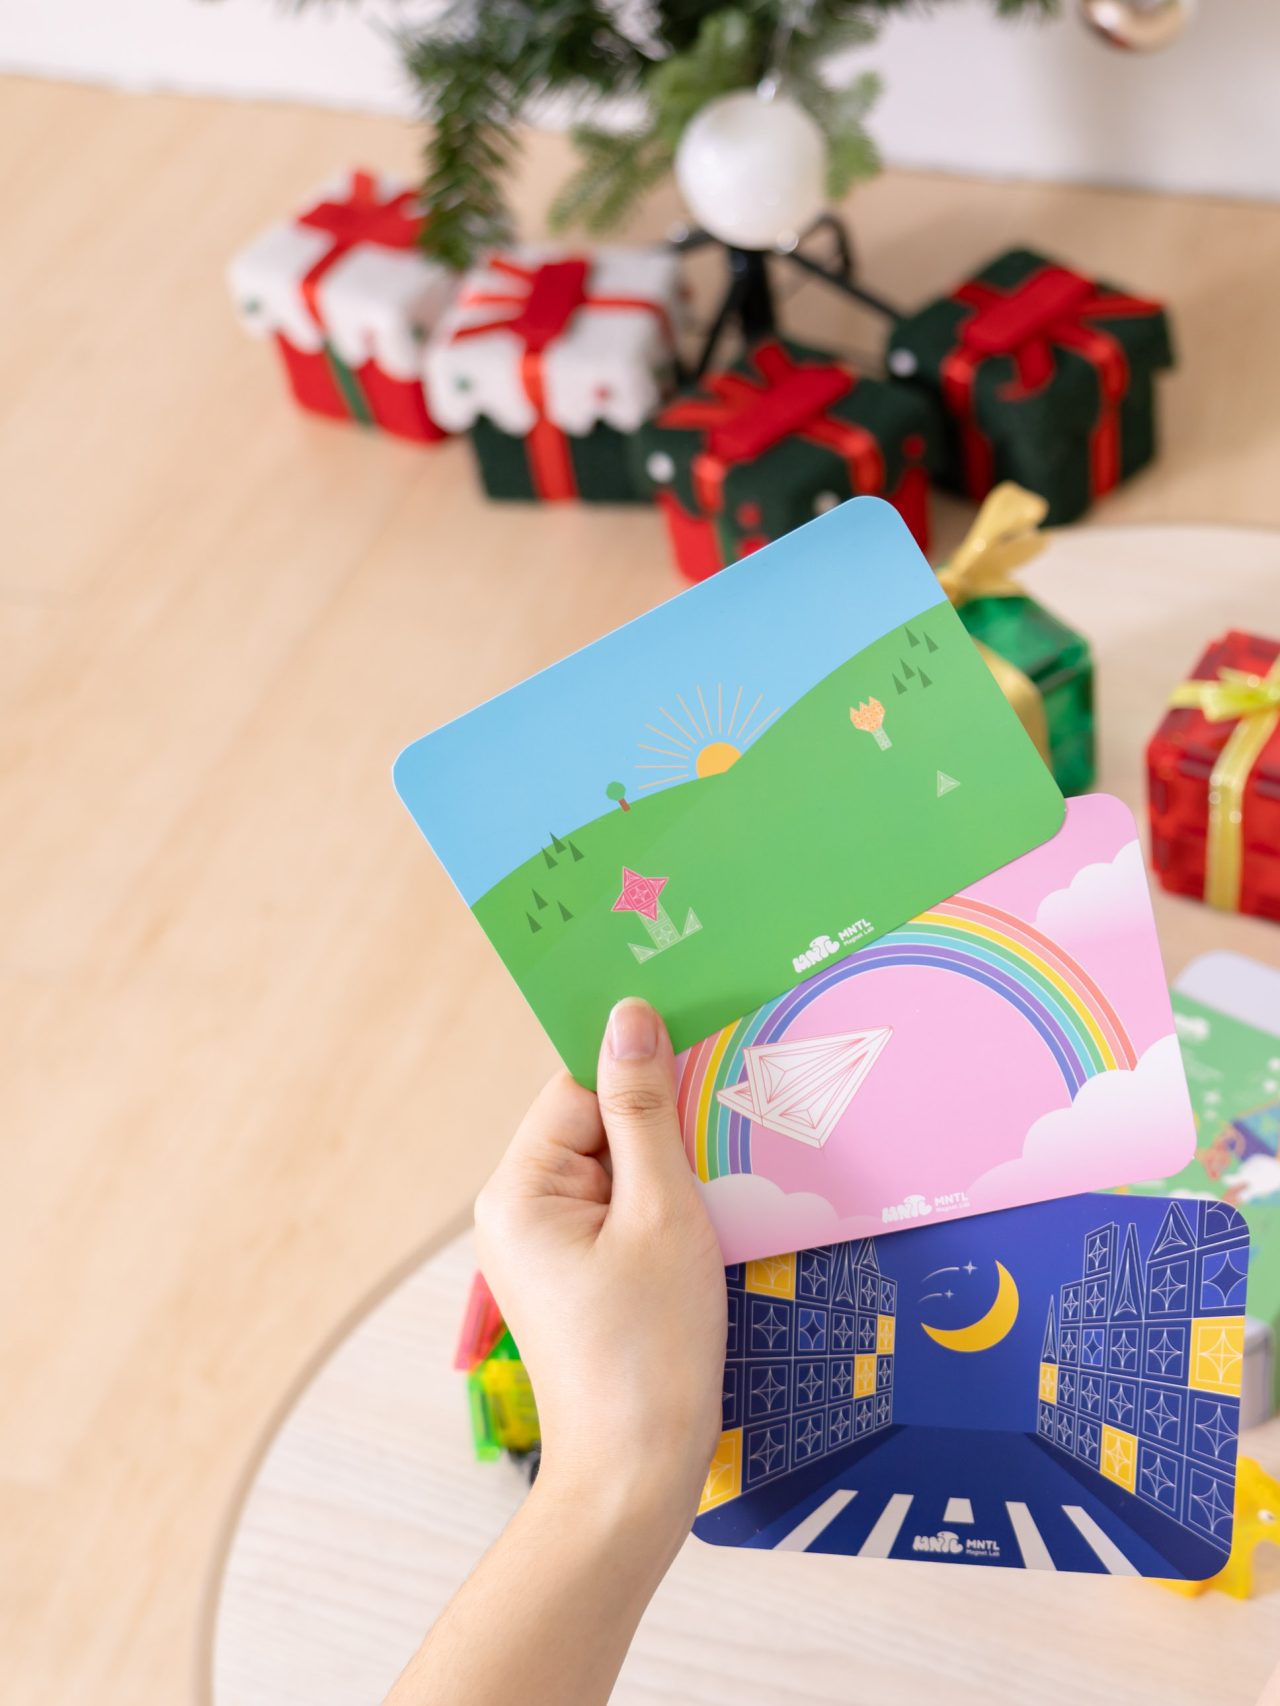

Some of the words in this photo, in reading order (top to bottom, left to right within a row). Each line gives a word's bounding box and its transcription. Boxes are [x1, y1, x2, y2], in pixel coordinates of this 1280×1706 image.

[838, 918, 872, 941] MNTL
[934, 1191, 968, 1206] MNTL
[965, 1538, 1000, 1550] MNTL
